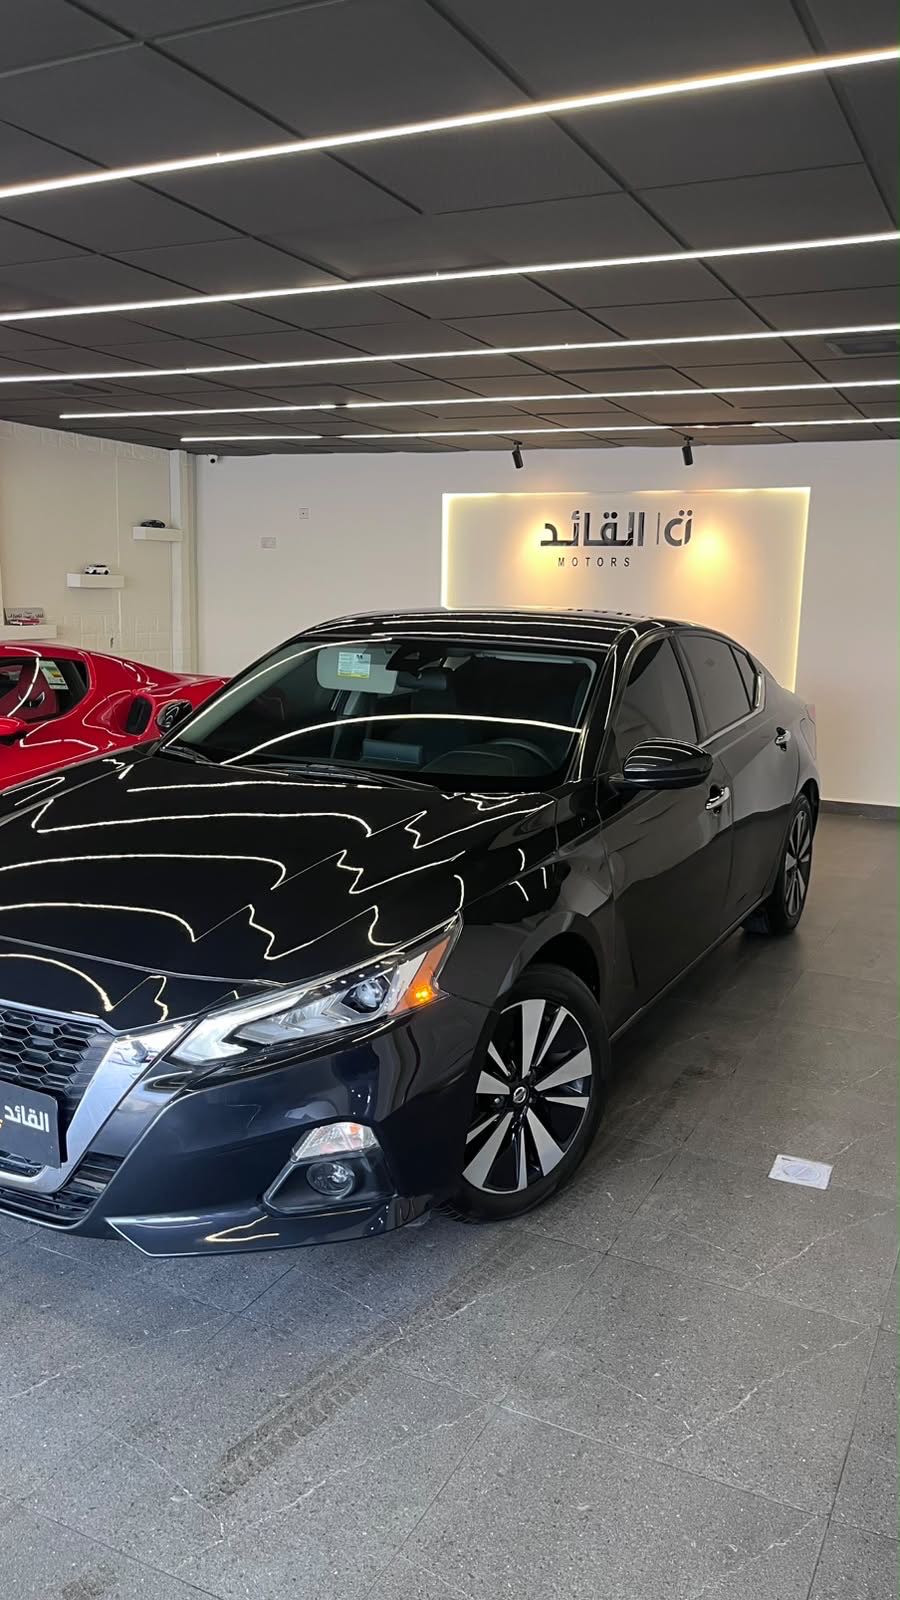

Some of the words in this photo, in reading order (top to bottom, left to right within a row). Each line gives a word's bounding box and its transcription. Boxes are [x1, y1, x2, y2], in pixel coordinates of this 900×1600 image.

[541, 510, 645, 547] القائد
[558, 557, 631, 567] MOTORS
[4, 1104, 49, 1133] القائد
